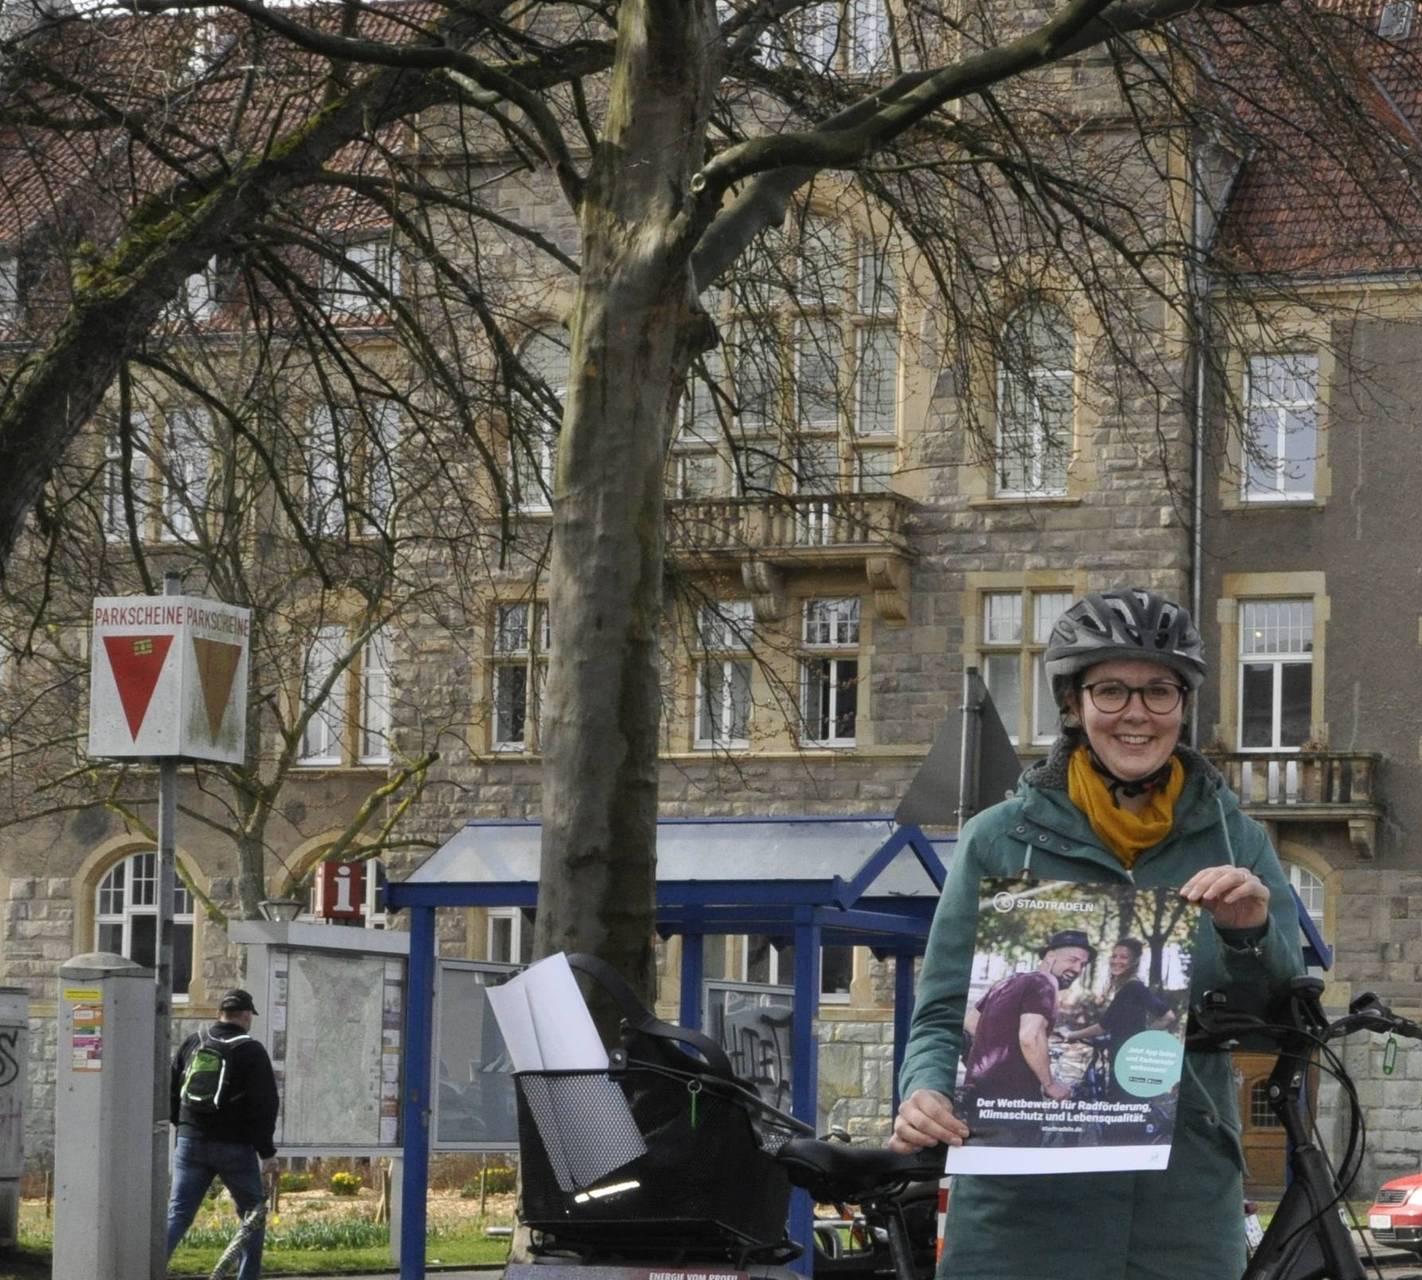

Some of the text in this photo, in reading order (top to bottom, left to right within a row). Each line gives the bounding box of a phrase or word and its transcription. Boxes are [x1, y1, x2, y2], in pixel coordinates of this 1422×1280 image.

[95, 606, 183, 626] PARKSCHEINE
[187, 606, 249, 637] PARKSCHEINE
[1016, 898, 1094, 912] STADTRADELN
[977, 1098, 1152, 1113] Der Wettbewerb für Radförderung,
[979, 1109, 1146, 1125] Klimaschutz und Lebensqualität.
